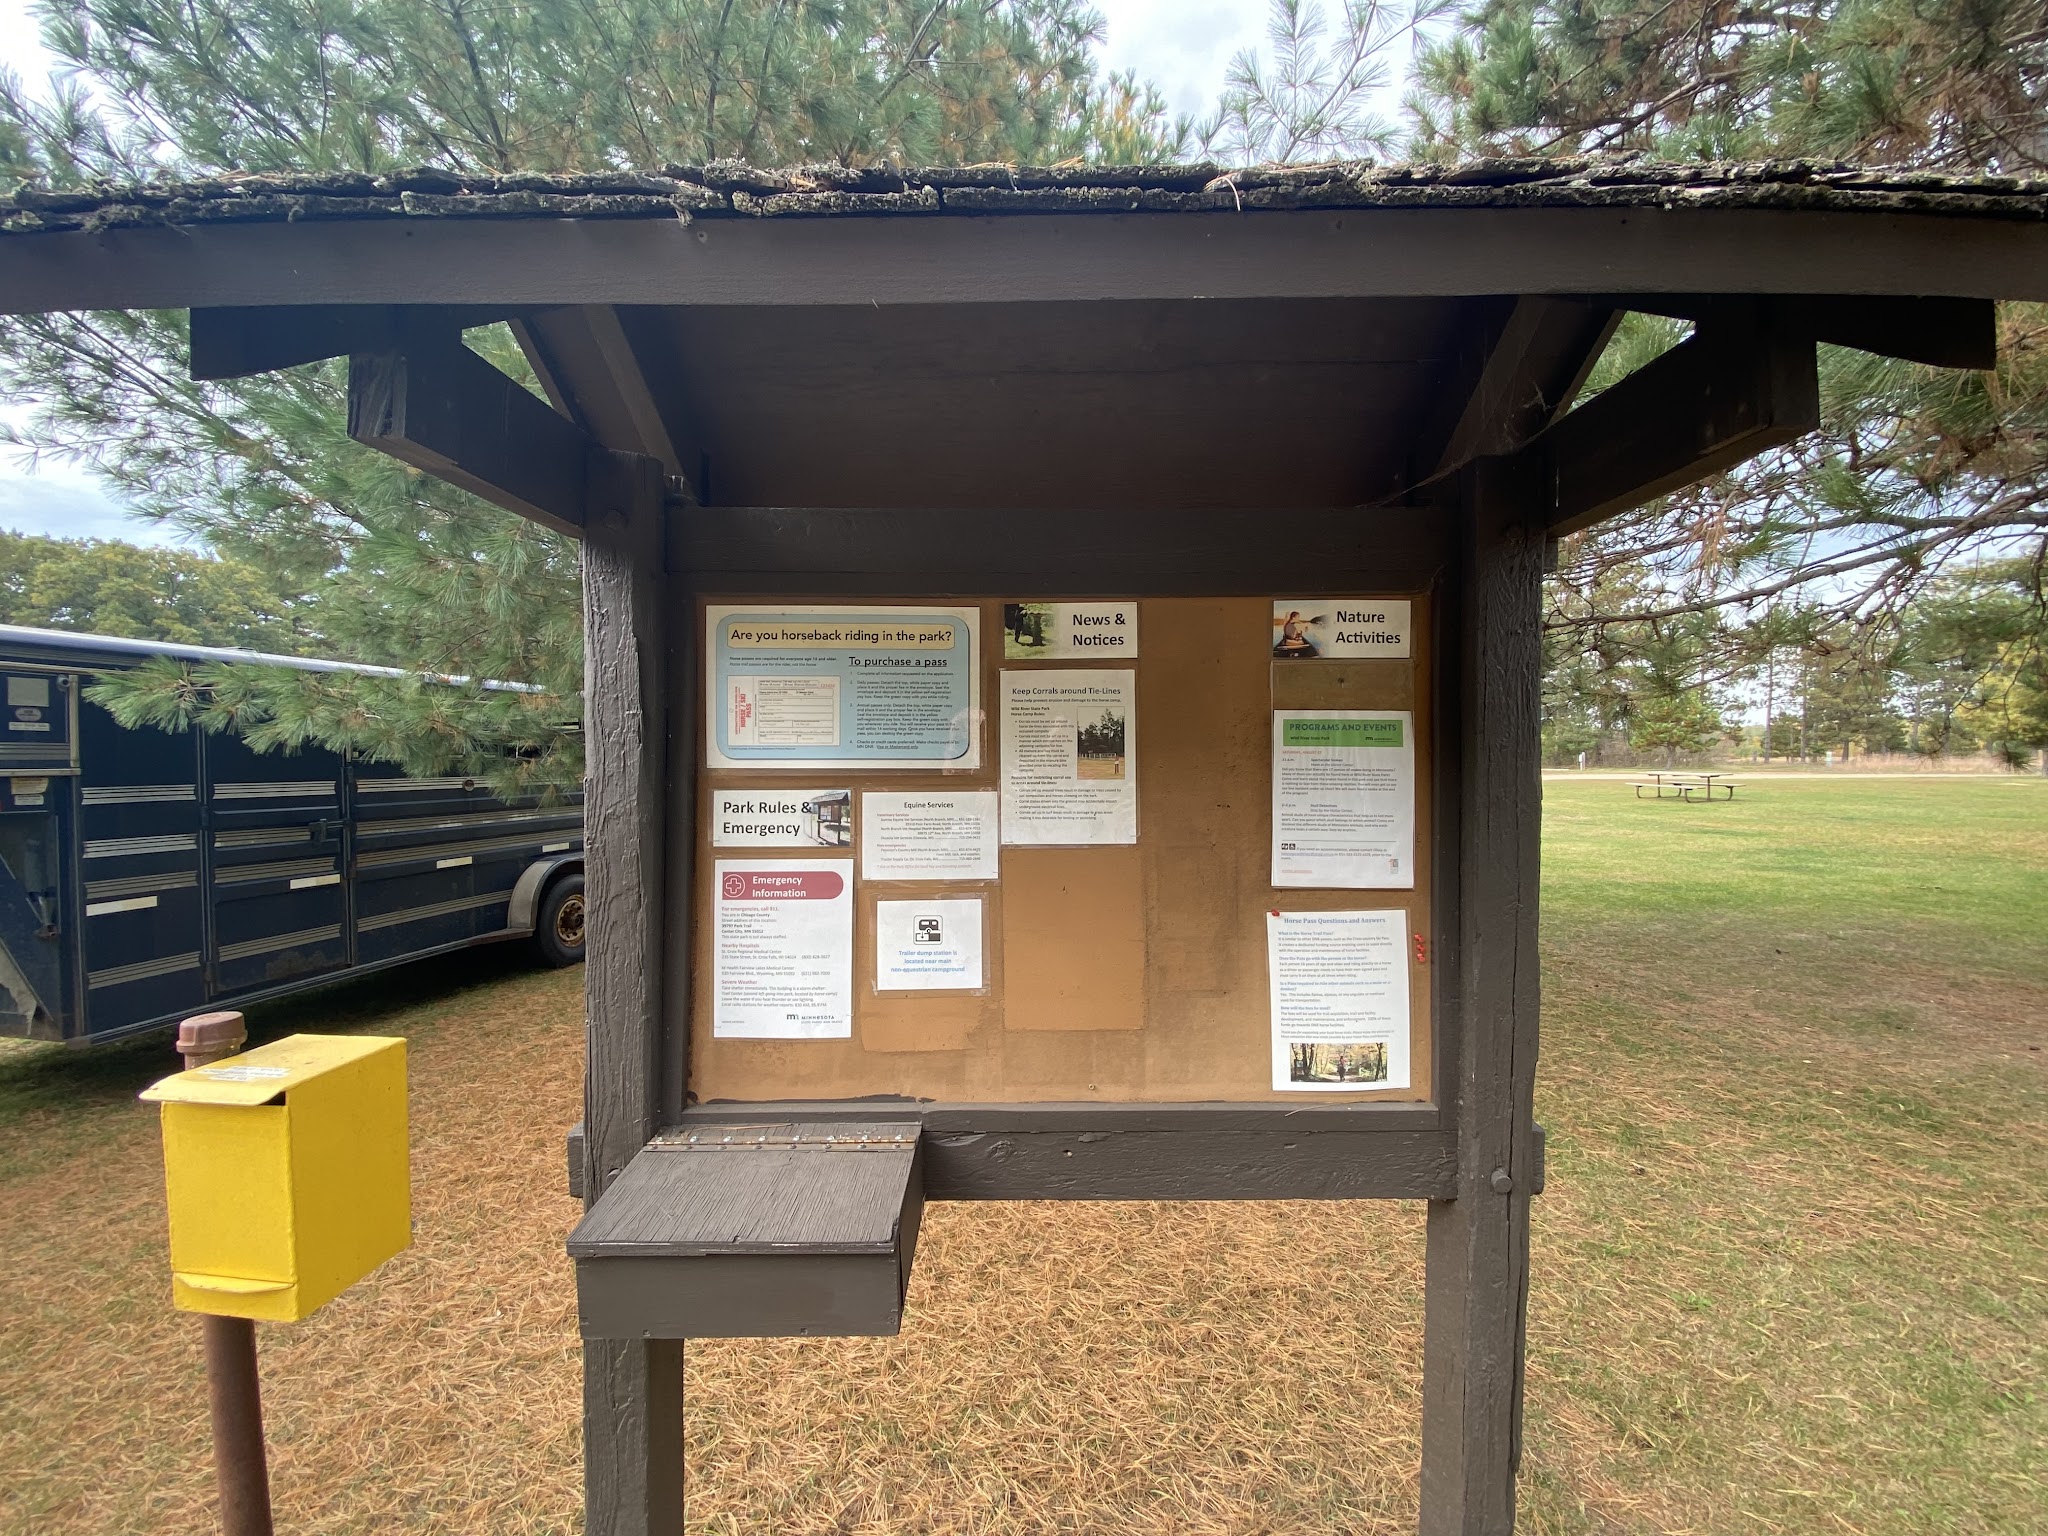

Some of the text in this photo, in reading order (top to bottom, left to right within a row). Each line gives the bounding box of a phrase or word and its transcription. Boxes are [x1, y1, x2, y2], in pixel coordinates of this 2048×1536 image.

[1072, 613, 1126, 626] News &
[1336, 610, 1385, 624] Nature
[731, 630, 952, 643] Are you horseback riding in the park?
[1072, 634, 1124, 646] Notices
[1336, 631, 1401, 644] Activities
[848, 657, 861, 665] To
[865, 657, 912, 667] purchase
[924, 659, 948, 667] pass
[723, 801, 812, 814] Park Rules &
[723, 822, 800, 836] Emergency
[752, 876, 802, 886] Emergency
[752, 888, 806, 897] Information
